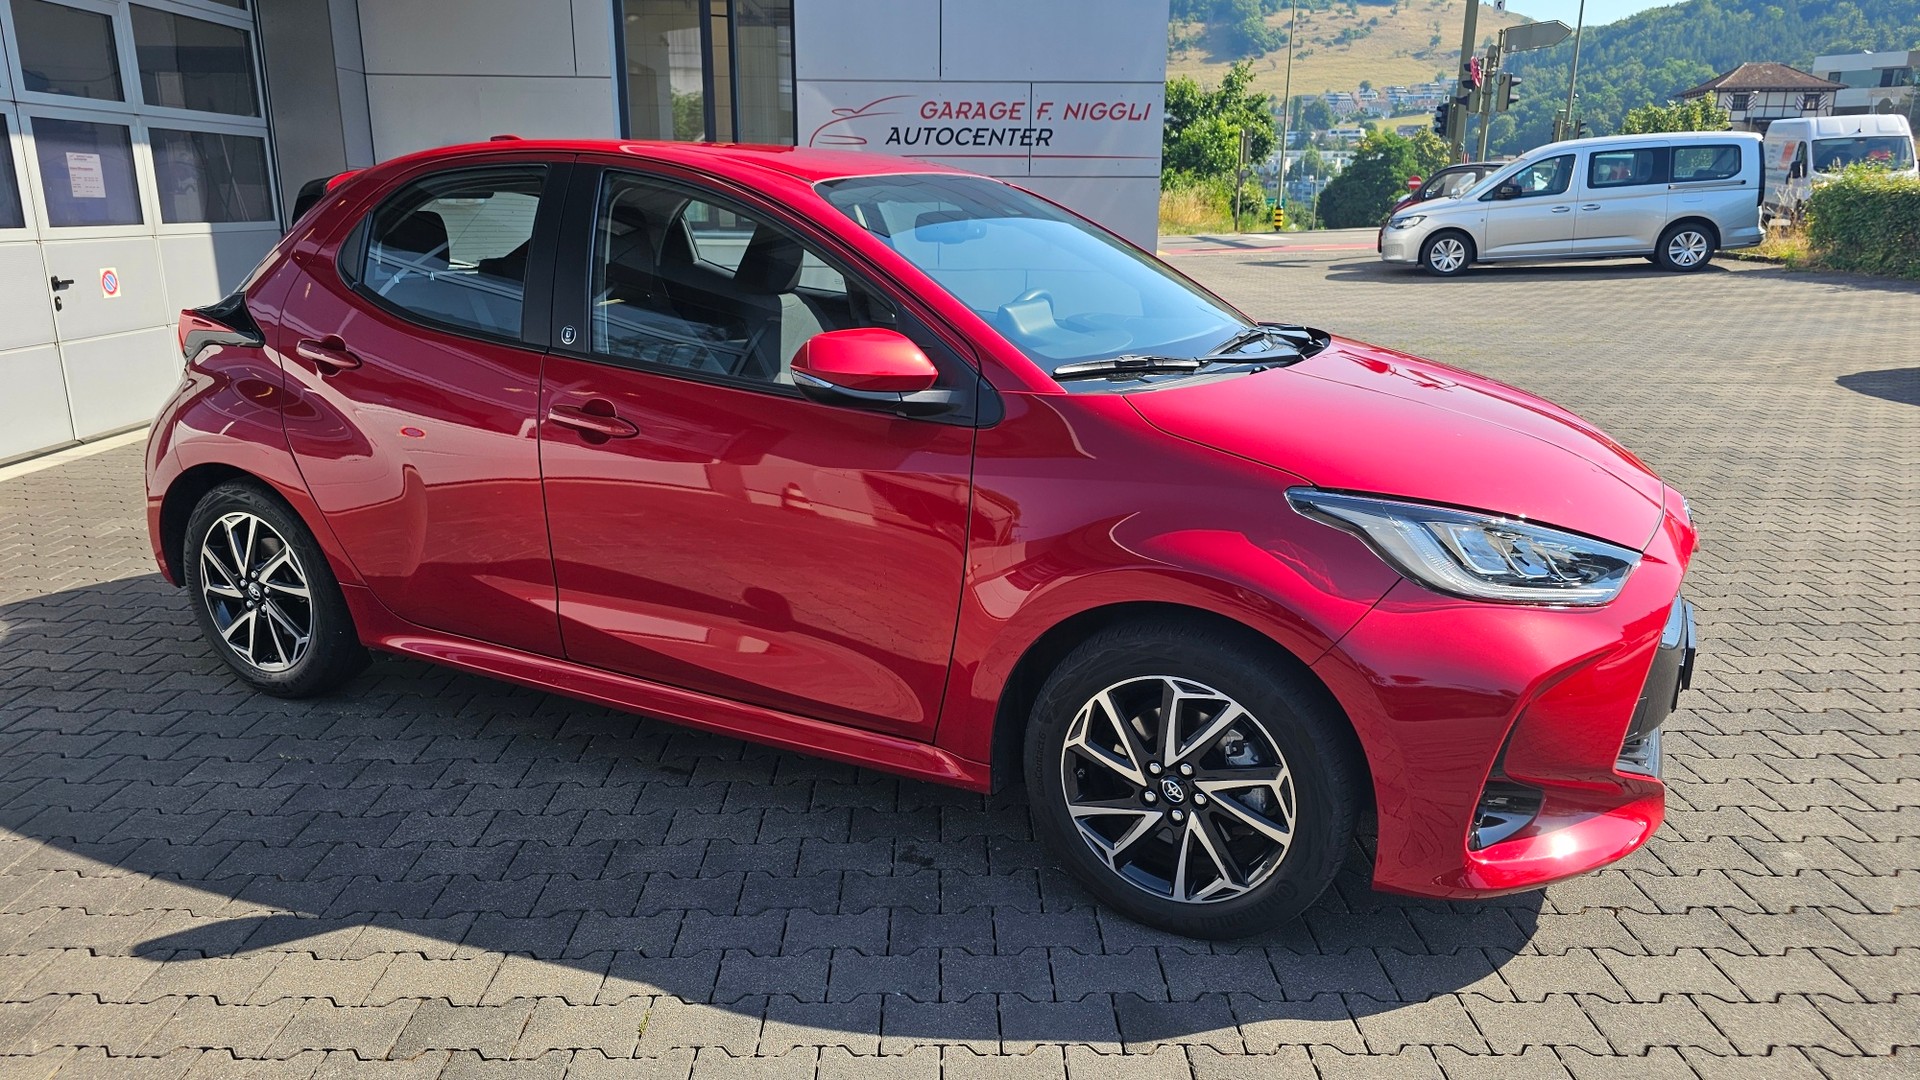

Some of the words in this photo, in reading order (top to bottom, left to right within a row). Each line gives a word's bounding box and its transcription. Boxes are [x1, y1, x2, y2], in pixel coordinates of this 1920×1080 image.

[920, 101, 1026, 120] GARAGE
[1036, 102, 1054, 121] F.
[1063, 102, 1152, 121] NIGGLI
[885, 127, 1054, 147] AUTOCENTER
